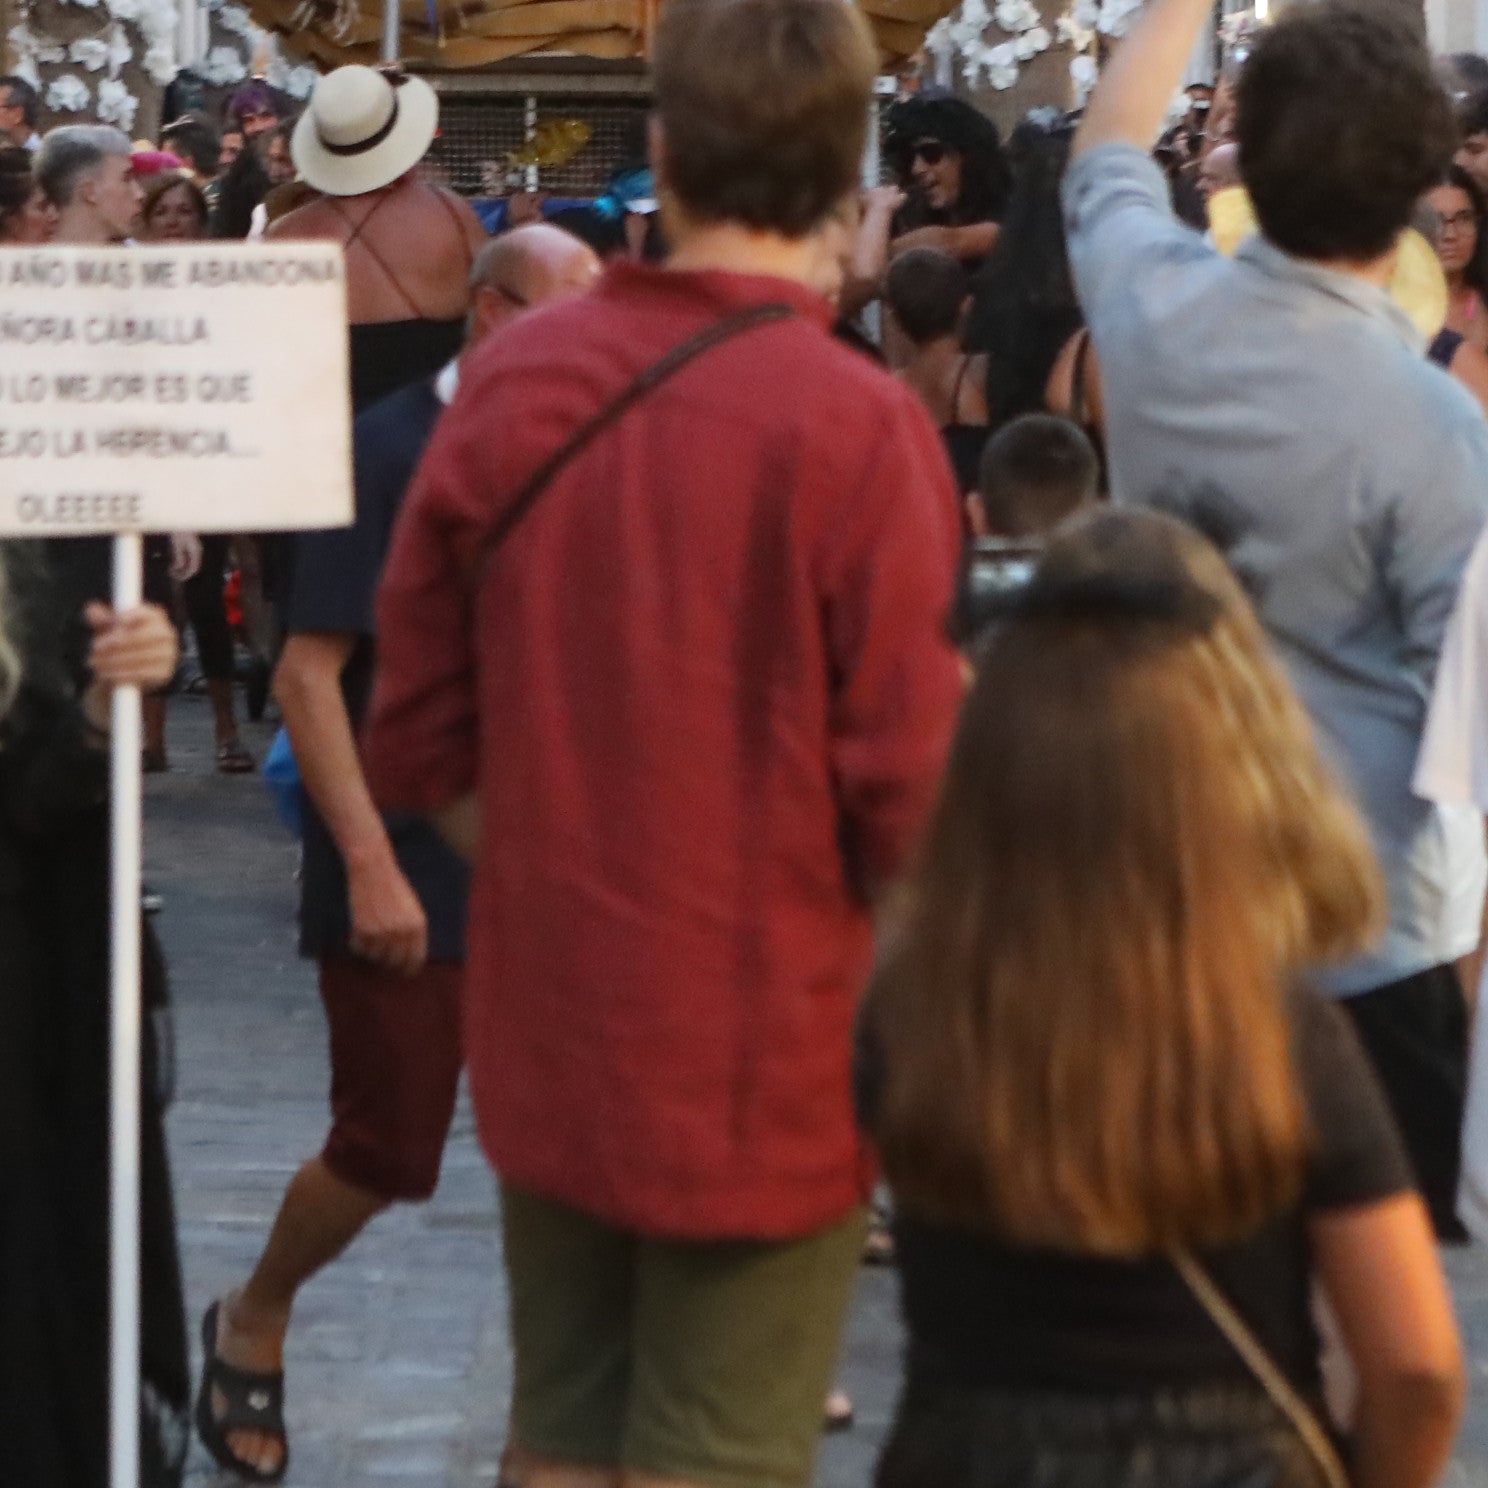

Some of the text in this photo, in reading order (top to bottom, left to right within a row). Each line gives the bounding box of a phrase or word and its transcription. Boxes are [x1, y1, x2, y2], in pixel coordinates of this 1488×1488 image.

[10, 254, 66, 289] AÑO
[188, 258, 336, 288] ABANDONA
[11, 375, 47, 405] LO
[56, 374, 146, 404] MEJOR
[154, 374, 189, 404] ES
[197, 373, 254, 404] QUE
[54, 429, 86, 459] LA
